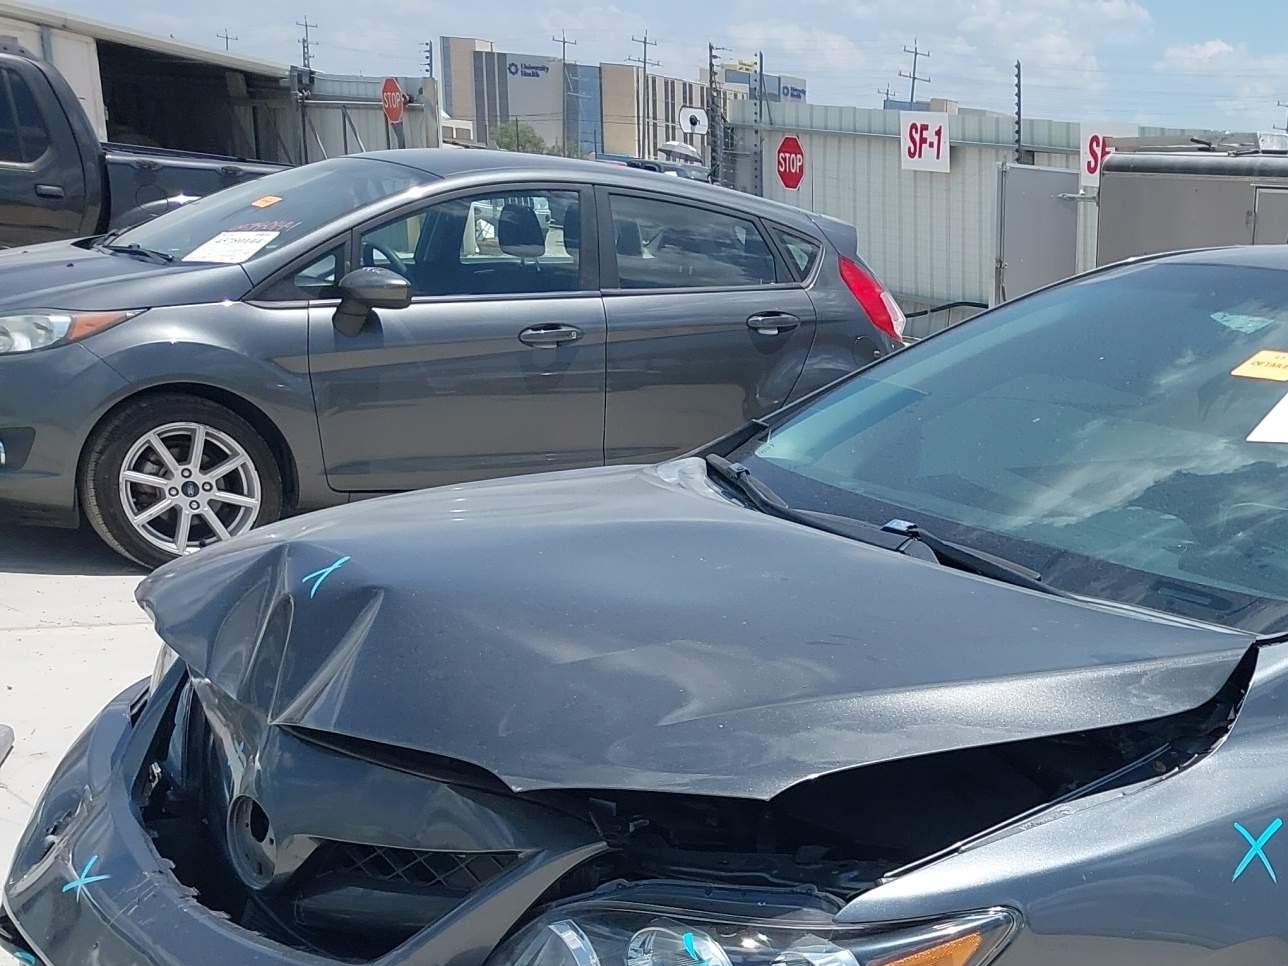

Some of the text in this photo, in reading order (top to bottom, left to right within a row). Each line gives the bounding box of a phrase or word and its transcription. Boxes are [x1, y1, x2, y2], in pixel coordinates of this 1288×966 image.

[383, 92, 401, 108] STOP
[907, 122, 943, 160] SF-1
[778, 152, 803, 173] STOP
